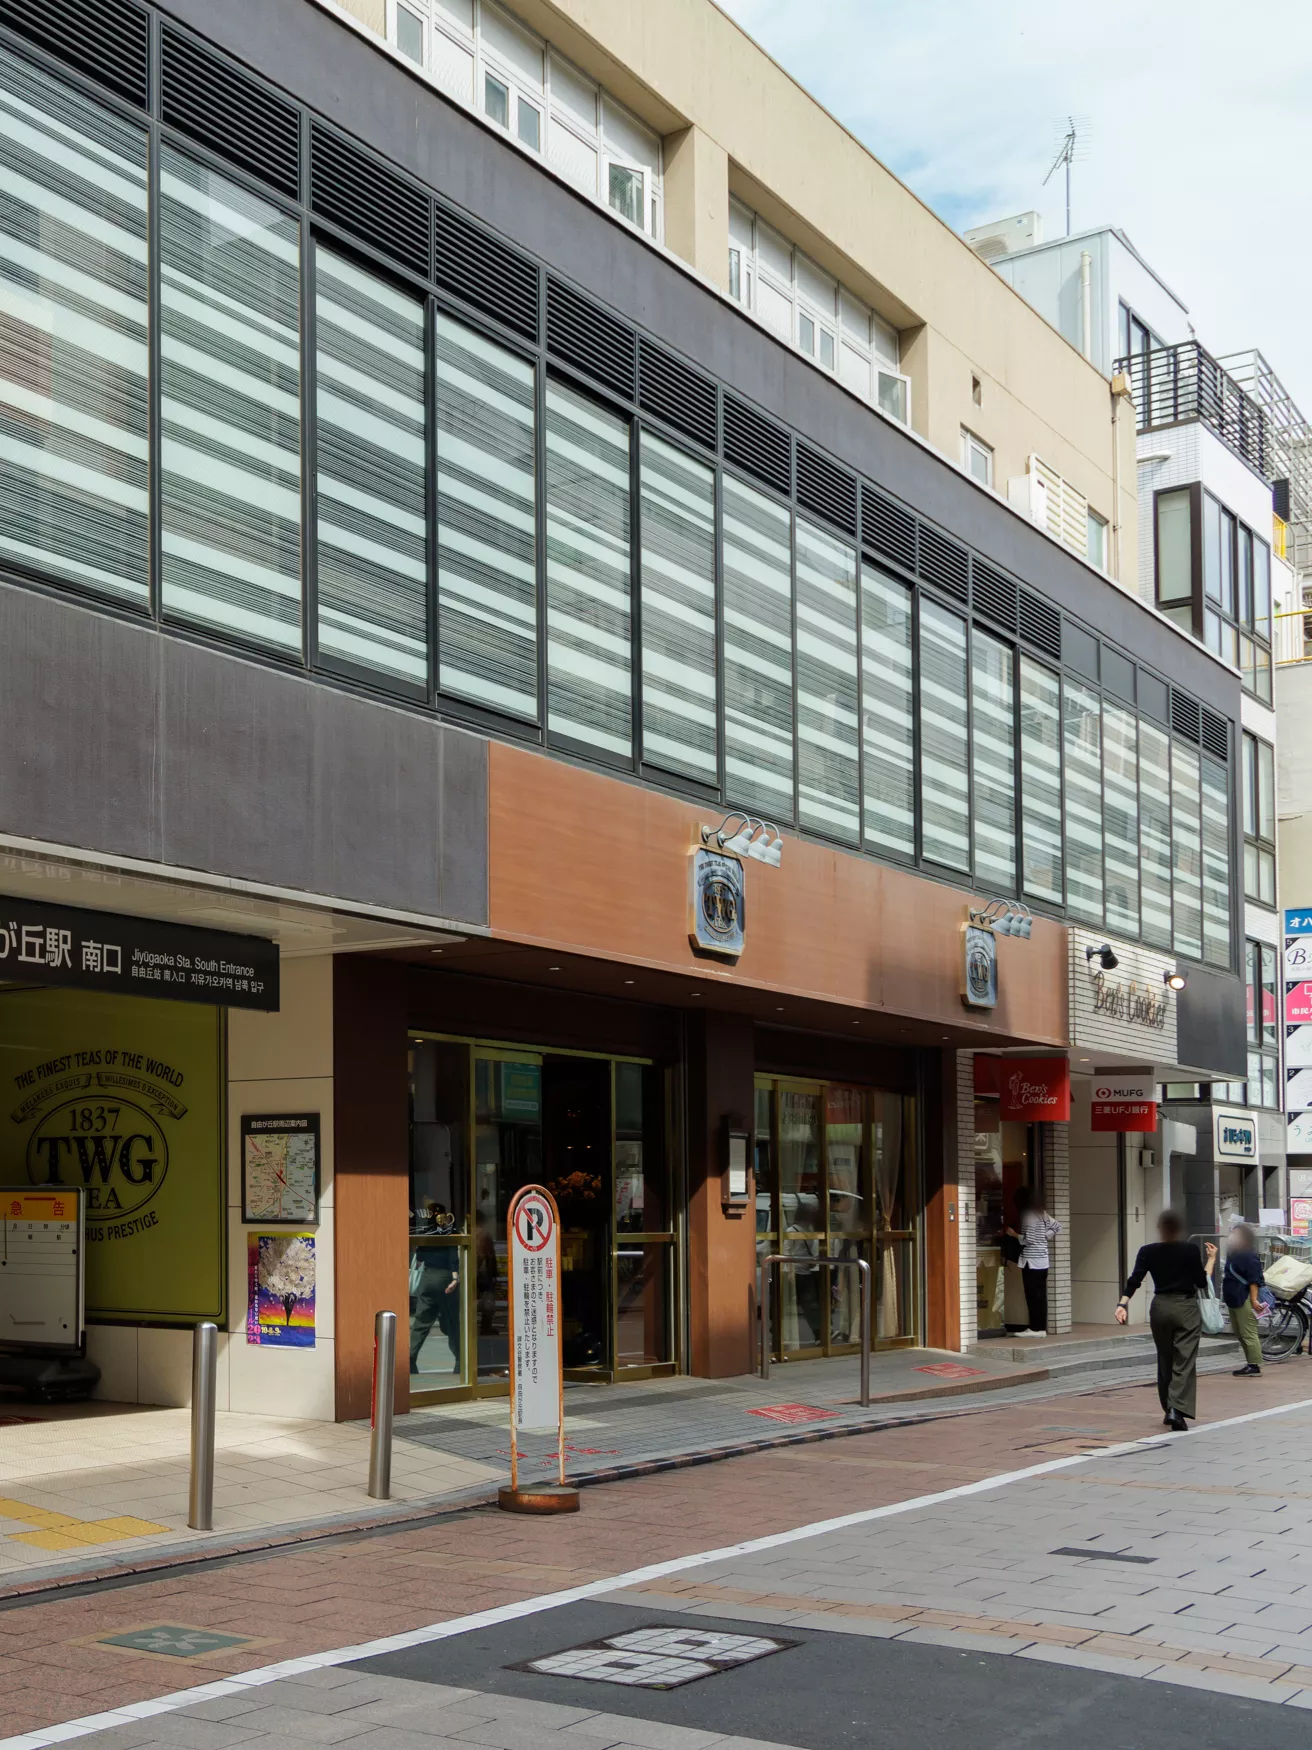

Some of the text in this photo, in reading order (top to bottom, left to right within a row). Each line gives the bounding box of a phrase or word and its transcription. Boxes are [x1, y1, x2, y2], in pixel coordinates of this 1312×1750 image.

[81, 940, 122, 975] 南口
[131, 948, 255, 977] Jiyūgaoka Sta. South Entrance
[131, 965, 186, 983] 自由丘站 南入口
[190, 973, 265, 994] 지유가오카역 남쪽 입구
[1094, 971, 1166, 1030] Ben's Cookies
[14, 1049, 184, 1091] THE FINEST TEAS OF THE WORLD
[55, 1077, 81, 1091] EXQUIS
[1020, 1082, 1049, 1094] Ben's
[1113, 1089, 1144, 1097] MUFG
[1021, 1093, 1058, 1105] Cookies
[1094, 1105, 1149, 1114] 三菱UFJ銀行
[69, 1106, 121, 1132] 1837
[36, 1134, 158, 1185] TWG
[85, 1187, 124, 1209] EA
[108, 1210, 159, 1241] PRESTIGE
[545, 1257, 554, 1337] 駐車・駐輪禁止
